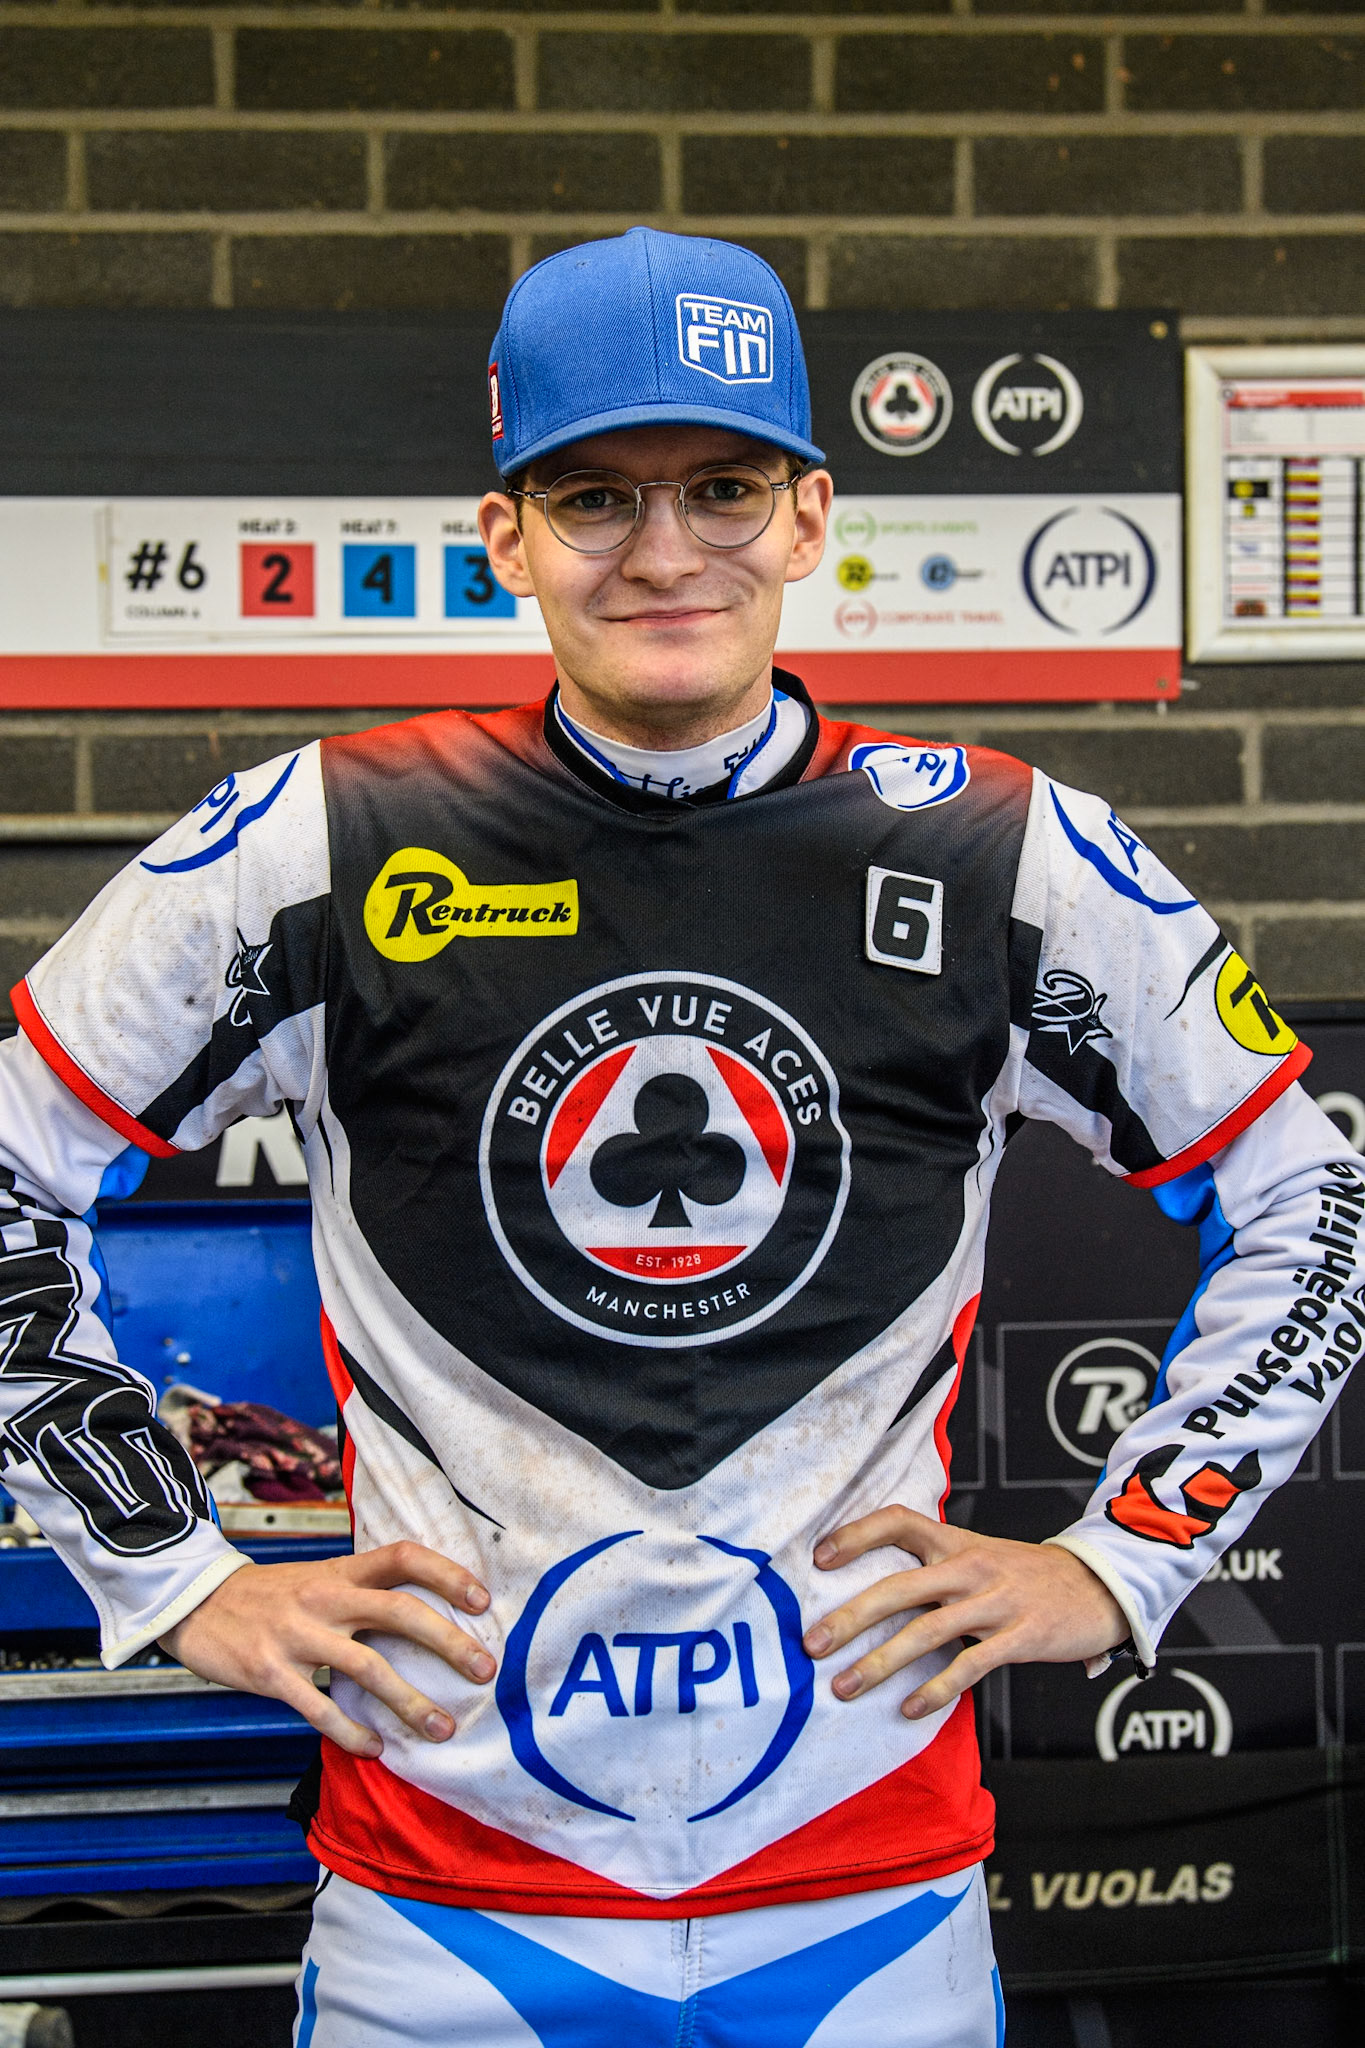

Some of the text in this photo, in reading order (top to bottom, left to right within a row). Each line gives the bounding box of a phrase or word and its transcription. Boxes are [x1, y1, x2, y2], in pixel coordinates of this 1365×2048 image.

[683, 302, 767, 334] TEAM
[991, 387, 1063, 421] ATPI
[126, 541, 206, 591] #6
[261, 554, 293, 603] 2
[362, 554, 393, 603] 4
[463, 556, 495, 604] 3
[1044, 553, 1132, 589] ATPI
[385, 872, 571, 939] Rentruck
[872, 875, 934, 961] 6
[507, 994, 822, 1126] BELLE VUE ACES
[636, 1253, 702, 1269] EST. 1928
[586, 1282, 751, 1319] MANCHESTER
[548, 1621, 760, 1718] ATPI
[1119, 1710, 1206, 1751] ATPI
[1030, 1862, 1236, 1911] VUOLAS
